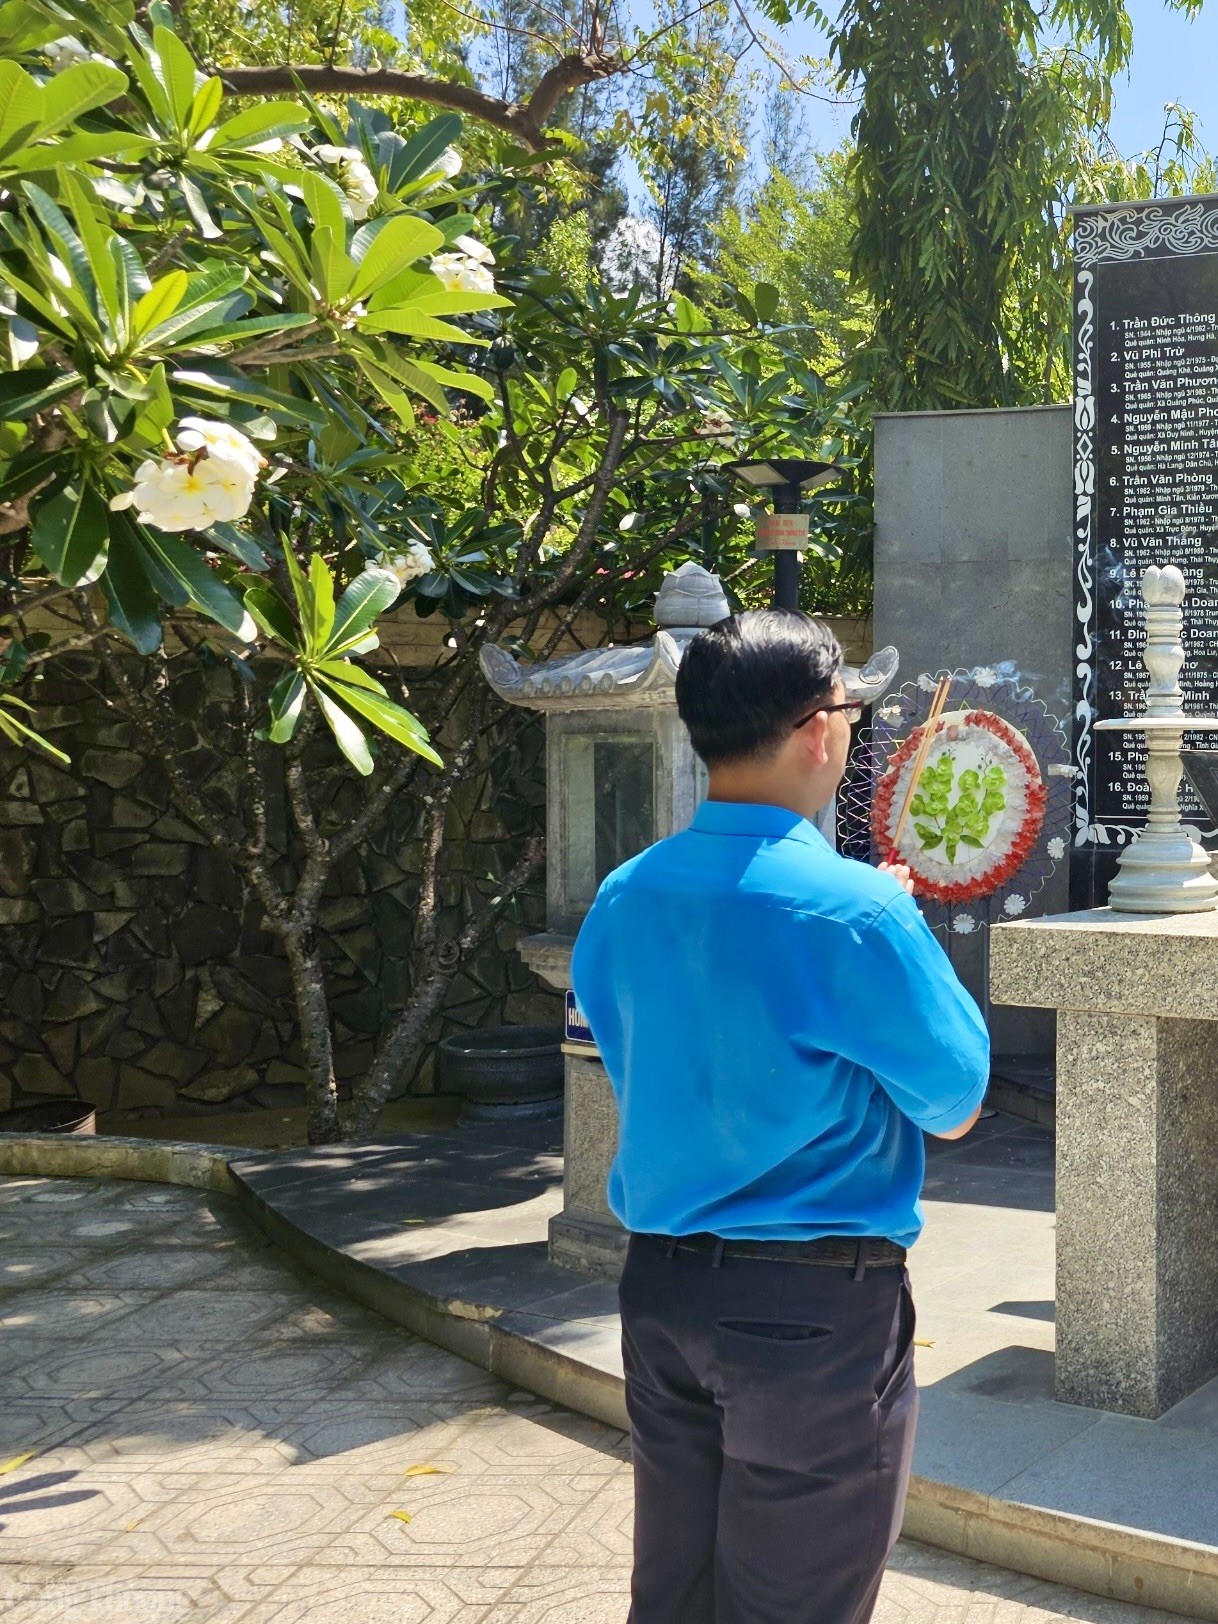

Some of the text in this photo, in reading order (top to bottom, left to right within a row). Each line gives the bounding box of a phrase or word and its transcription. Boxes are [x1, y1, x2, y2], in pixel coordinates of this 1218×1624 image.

[1109, 312, 1215, 330] 1. Trần Đức Thông
[1110, 351, 1120, 362] 2.
[1123, 347, 1139, 361] Vũ
[1163, 345, 1185, 357] Trừ
[1110, 383, 1120, 392] 3.
[1122, 375, 1150, 392] Trần
[1151, 376, 1175, 389] Văn
[1110, 445, 1121, 455] 5.
[1123, 437, 1169, 455] Nguyễn
[1170, 437, 1198, 451] Minh
[1110, 498, 1213, 518] 7. Phạm Gia Thiều
